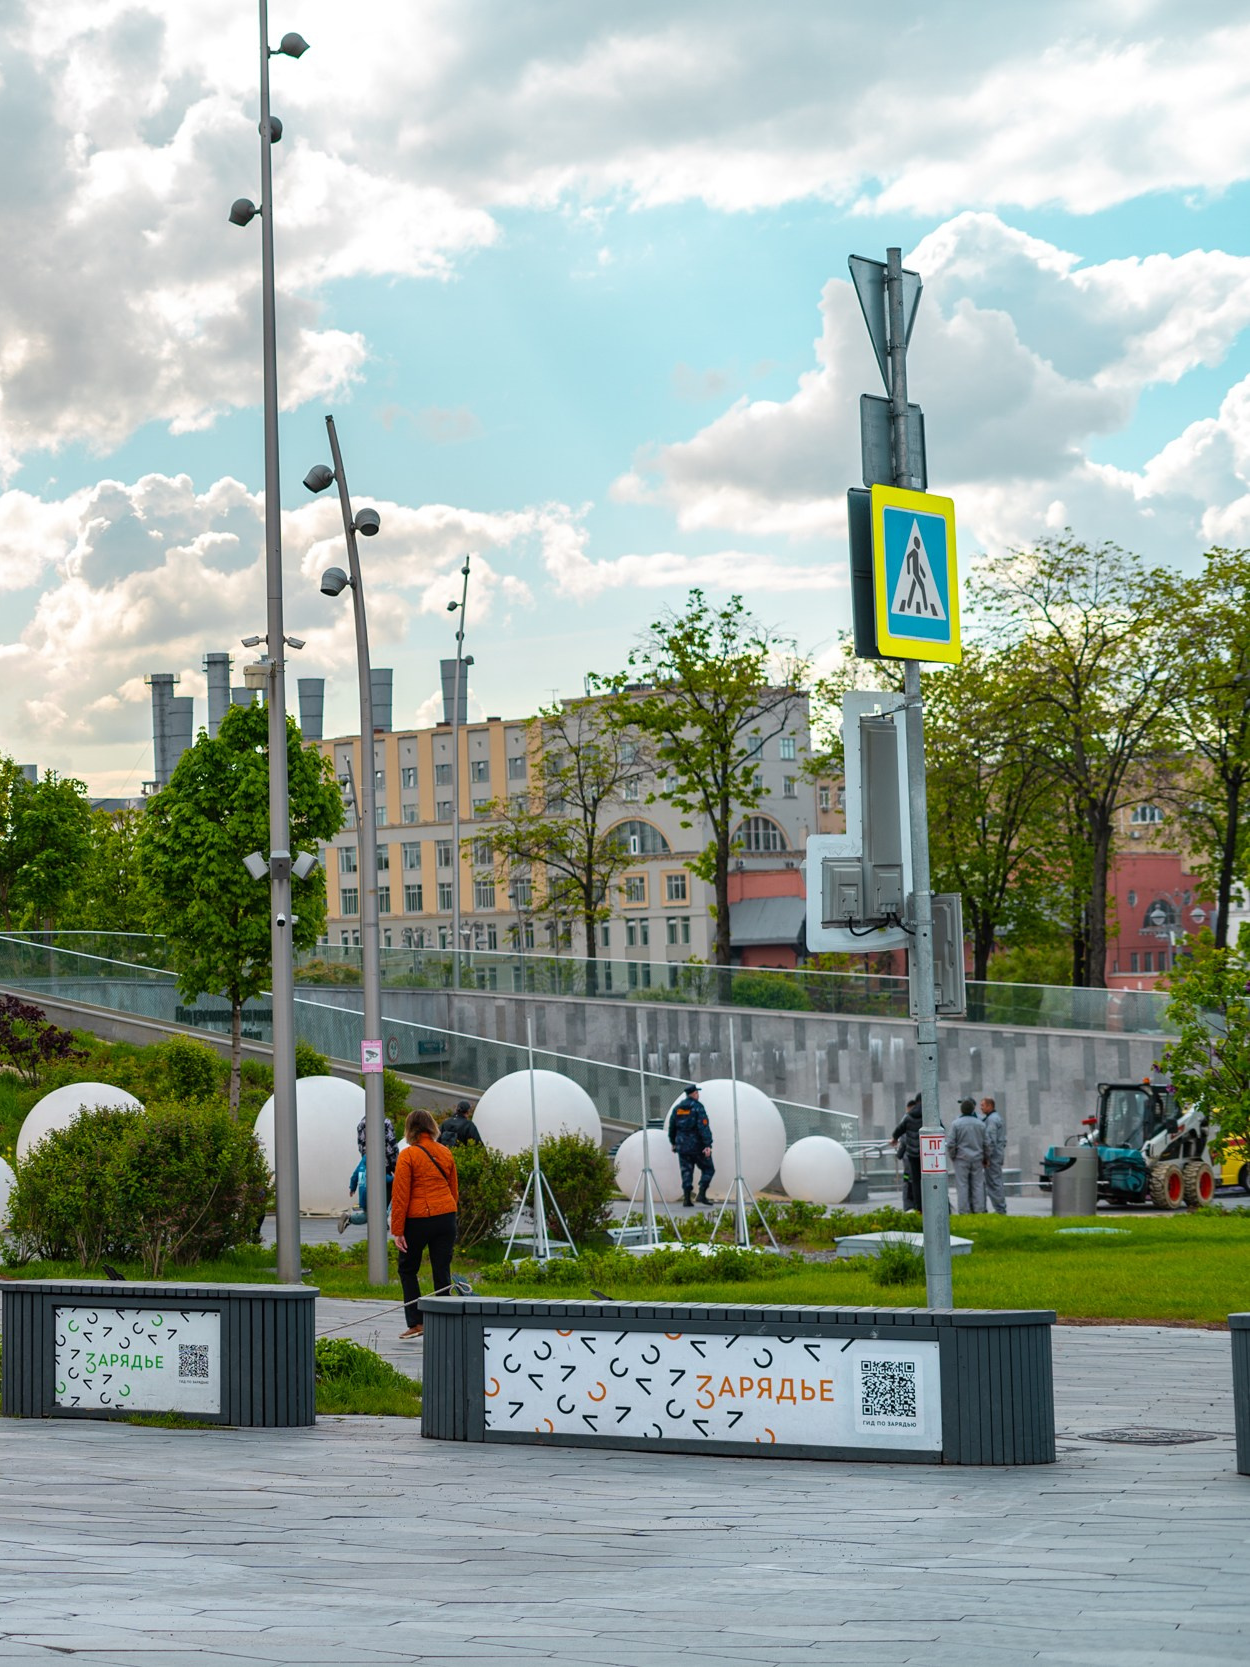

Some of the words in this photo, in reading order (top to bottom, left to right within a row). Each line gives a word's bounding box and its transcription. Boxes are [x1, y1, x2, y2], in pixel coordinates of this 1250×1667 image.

[840, 1122, 853, 1130] WC
[929, 1139, 942, 1150] ПГ
[85, 1353, 164, 1374] ЗАРЯДЬЕ
[696, 1375, 835, 1409] ЗАРЯДЬЕ
